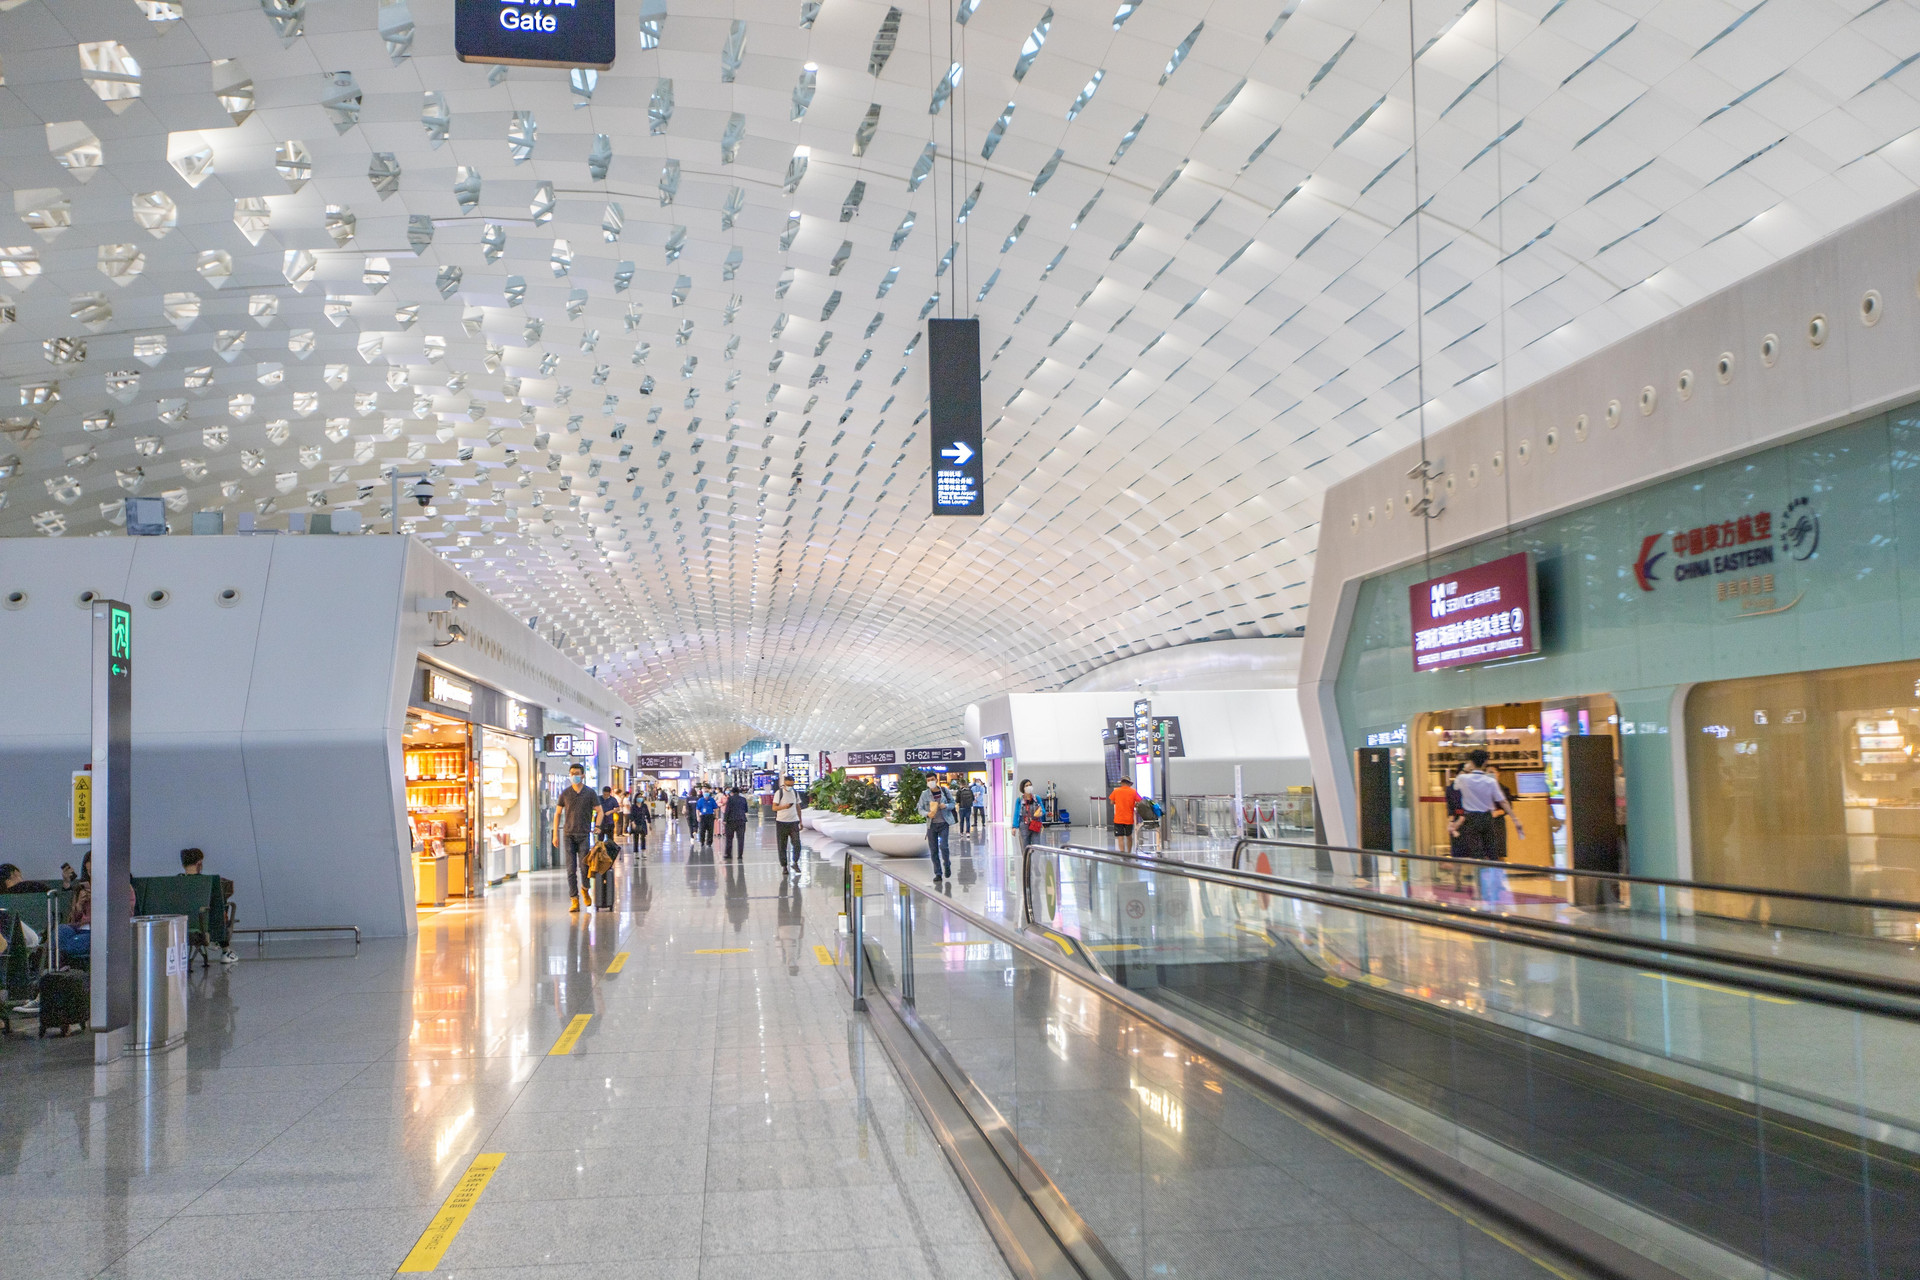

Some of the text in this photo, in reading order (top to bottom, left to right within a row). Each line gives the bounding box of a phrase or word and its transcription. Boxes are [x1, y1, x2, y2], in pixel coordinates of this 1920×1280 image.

[500, 7, 557, 32] Gate
[1674, 545, 1774, 582] CHINA EASTERN
[870, 753, 887, 762] 14-26
[906, 751, 928, 760] 51-62
